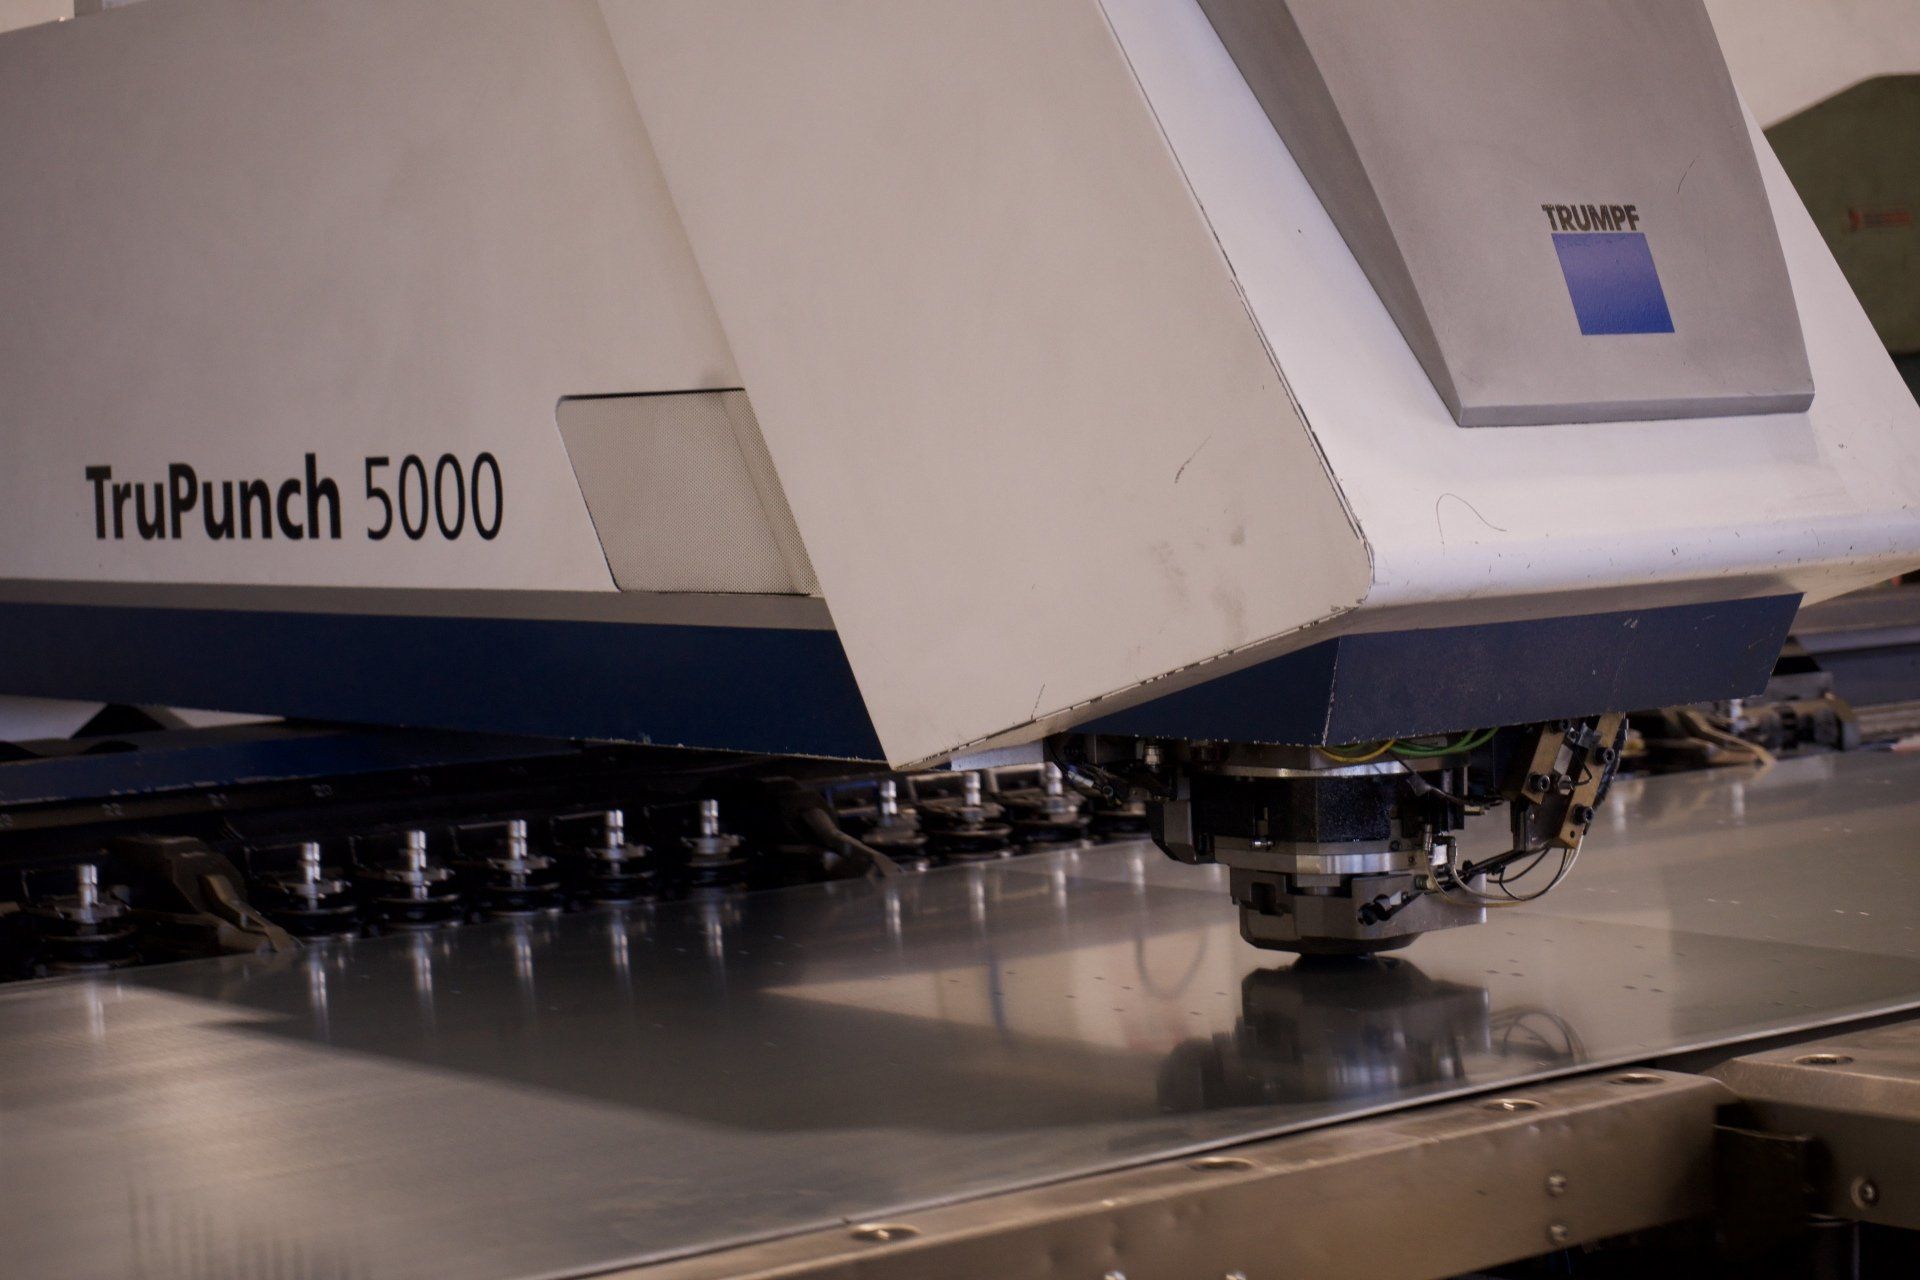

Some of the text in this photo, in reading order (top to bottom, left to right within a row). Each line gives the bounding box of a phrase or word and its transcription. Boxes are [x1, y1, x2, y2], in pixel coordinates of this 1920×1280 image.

[1541, 204, 1640, 231] TRUMPF
[86, 452, 504, 540] TruPunch 5000
